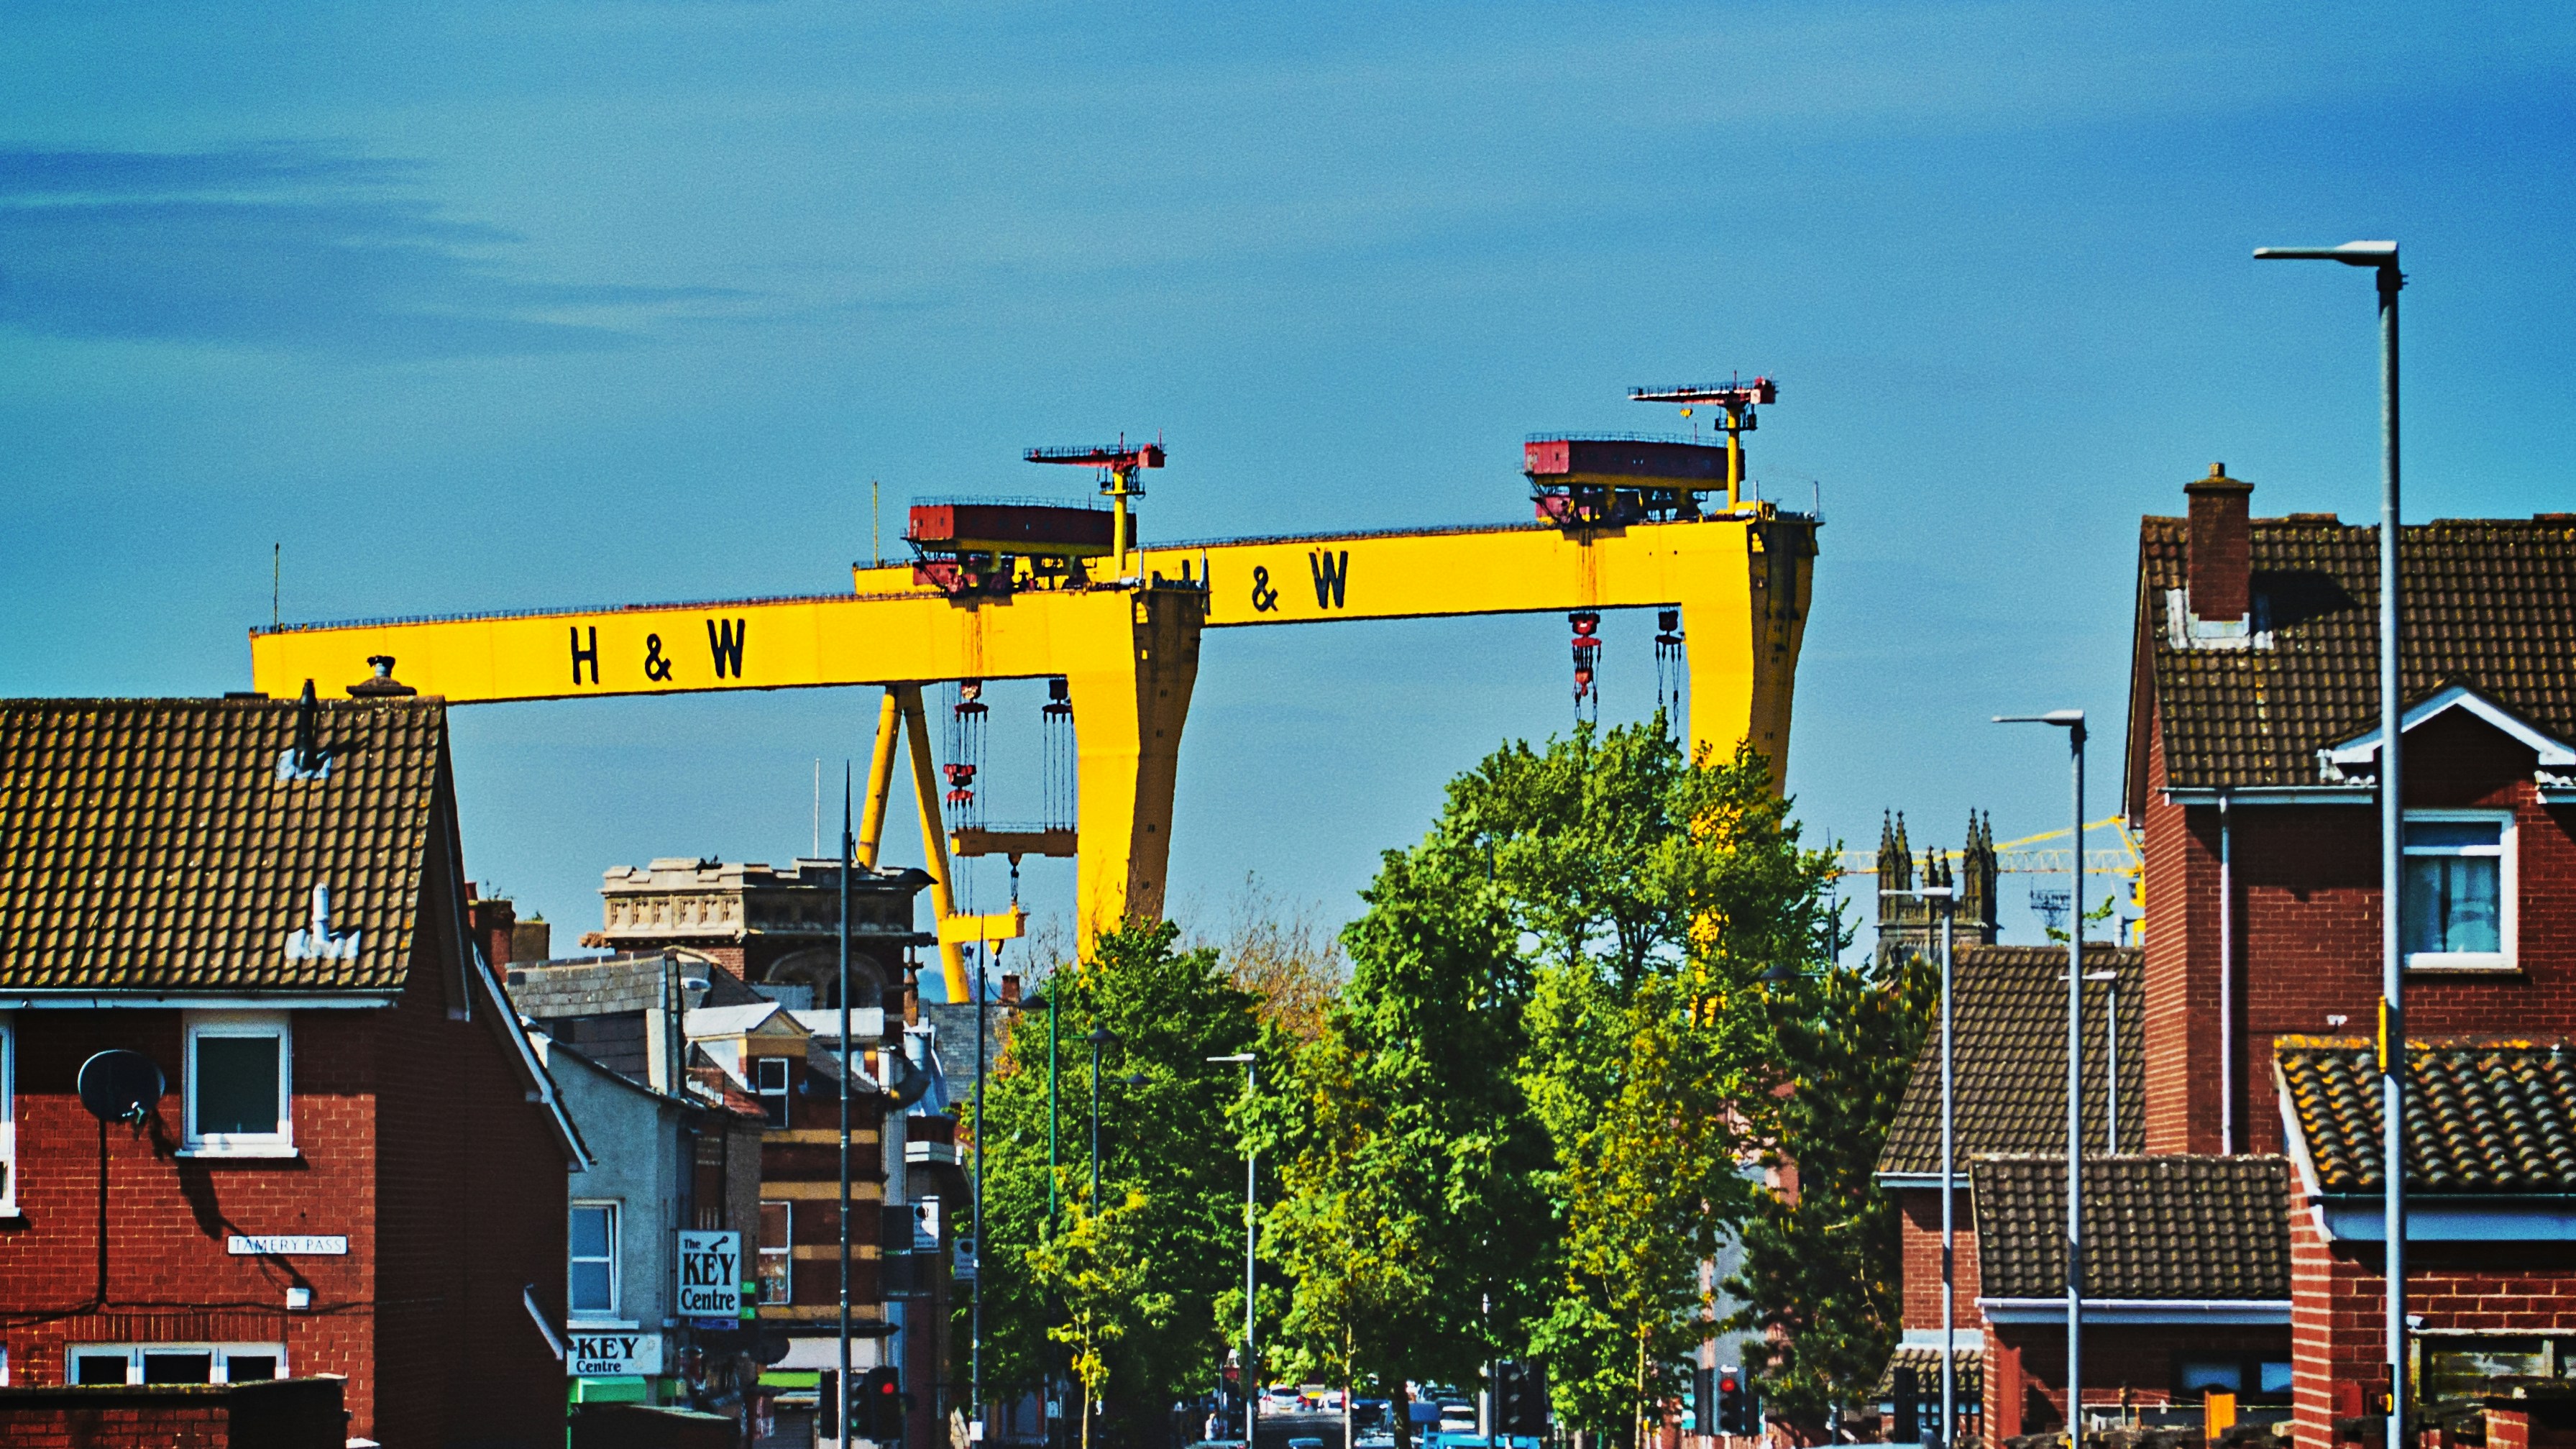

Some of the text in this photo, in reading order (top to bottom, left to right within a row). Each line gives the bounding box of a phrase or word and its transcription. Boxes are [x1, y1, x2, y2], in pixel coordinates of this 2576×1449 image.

[1252, 566, 1278, 612] &
[1308, 551, 1348, 609] W
[570, 618, 746, 685] H & W
[234, 1238, 342, 1251] TAMERY PASS
[684, 1238, 701, 1249] The
[682, 1253, 736, 1286] KEY
[681, 1288, 735, 1310] Centre
[577, 1338, 639, 1359] KEY
[576, 1360, 621, 1373] Centre
